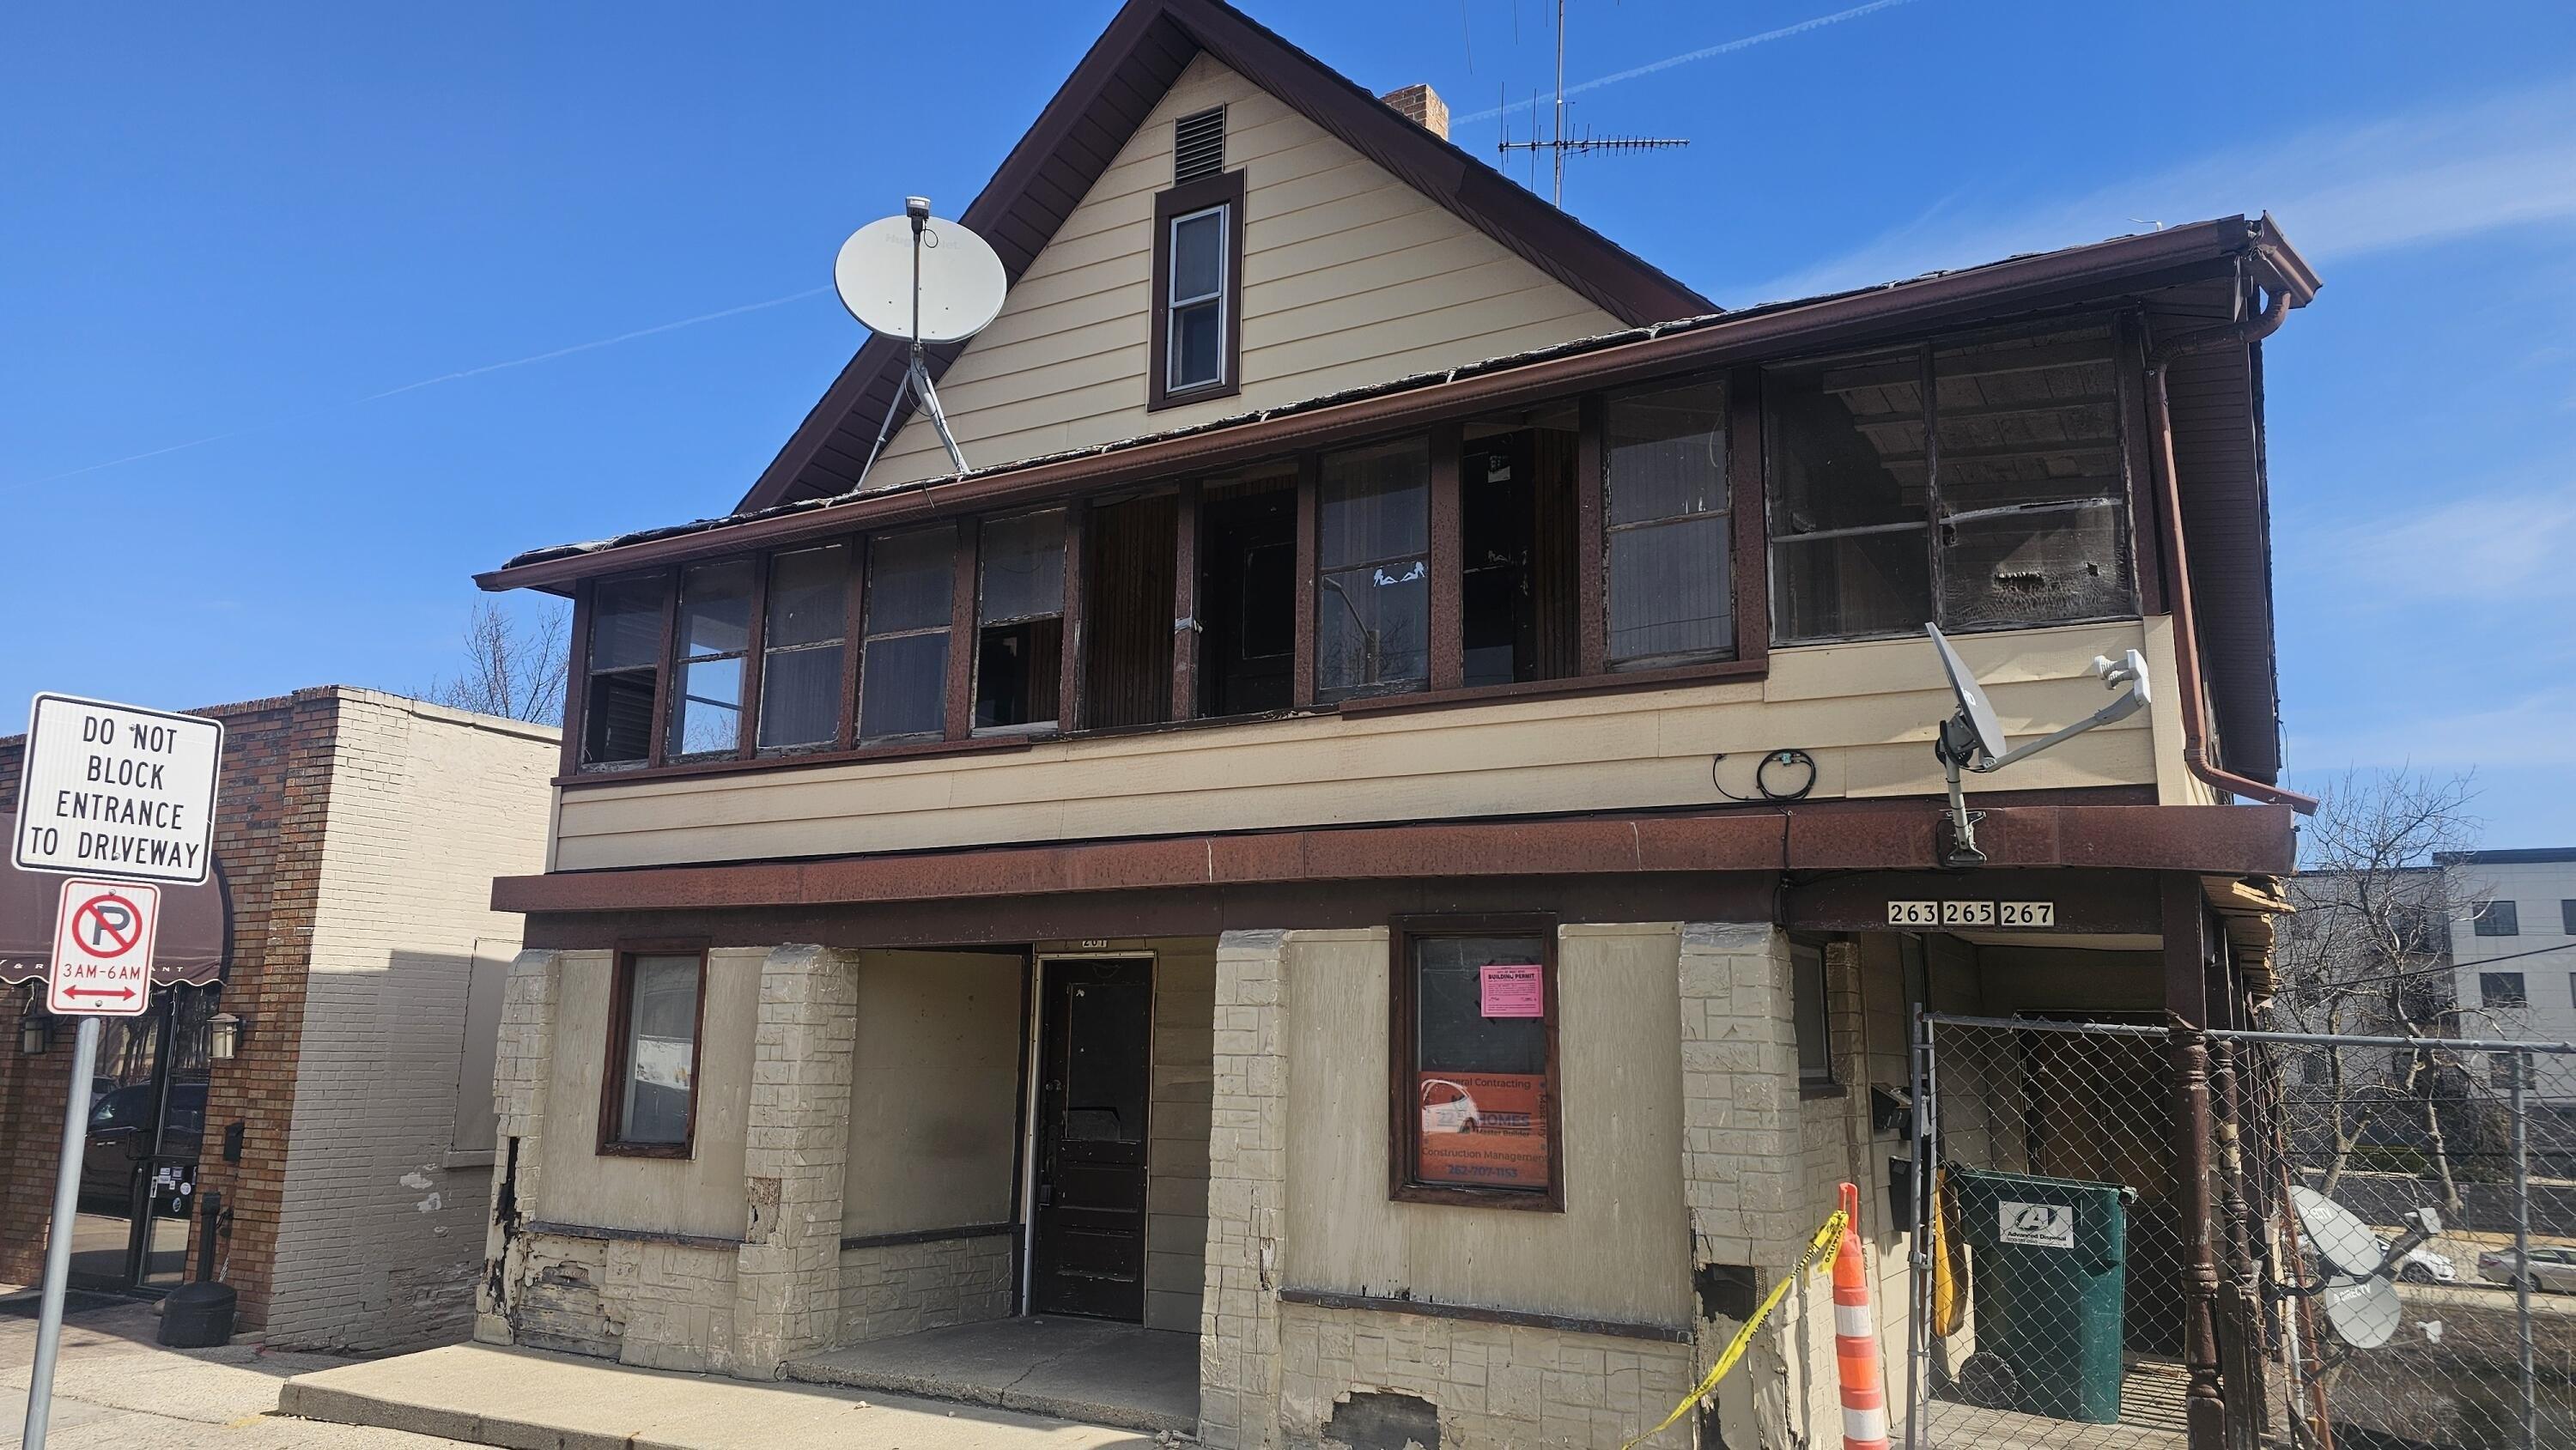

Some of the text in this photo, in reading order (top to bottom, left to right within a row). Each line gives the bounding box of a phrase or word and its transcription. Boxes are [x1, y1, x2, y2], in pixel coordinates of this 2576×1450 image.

[83, 716, 177, 754] DO NOT
[87, 755, 165, 790] BLOCK
[57, 790, 184, 830] ENTRANCE
[32, 827, 199, 868] TO DRIVEWAY
[1891, 904, 2051, 924] 263 265 267
[1475, 1078, 1531, 1089] Contracting
[1477, 1113, 1530, 1126] HOMES
[1422, 1147, 1481, 1158] Construction
